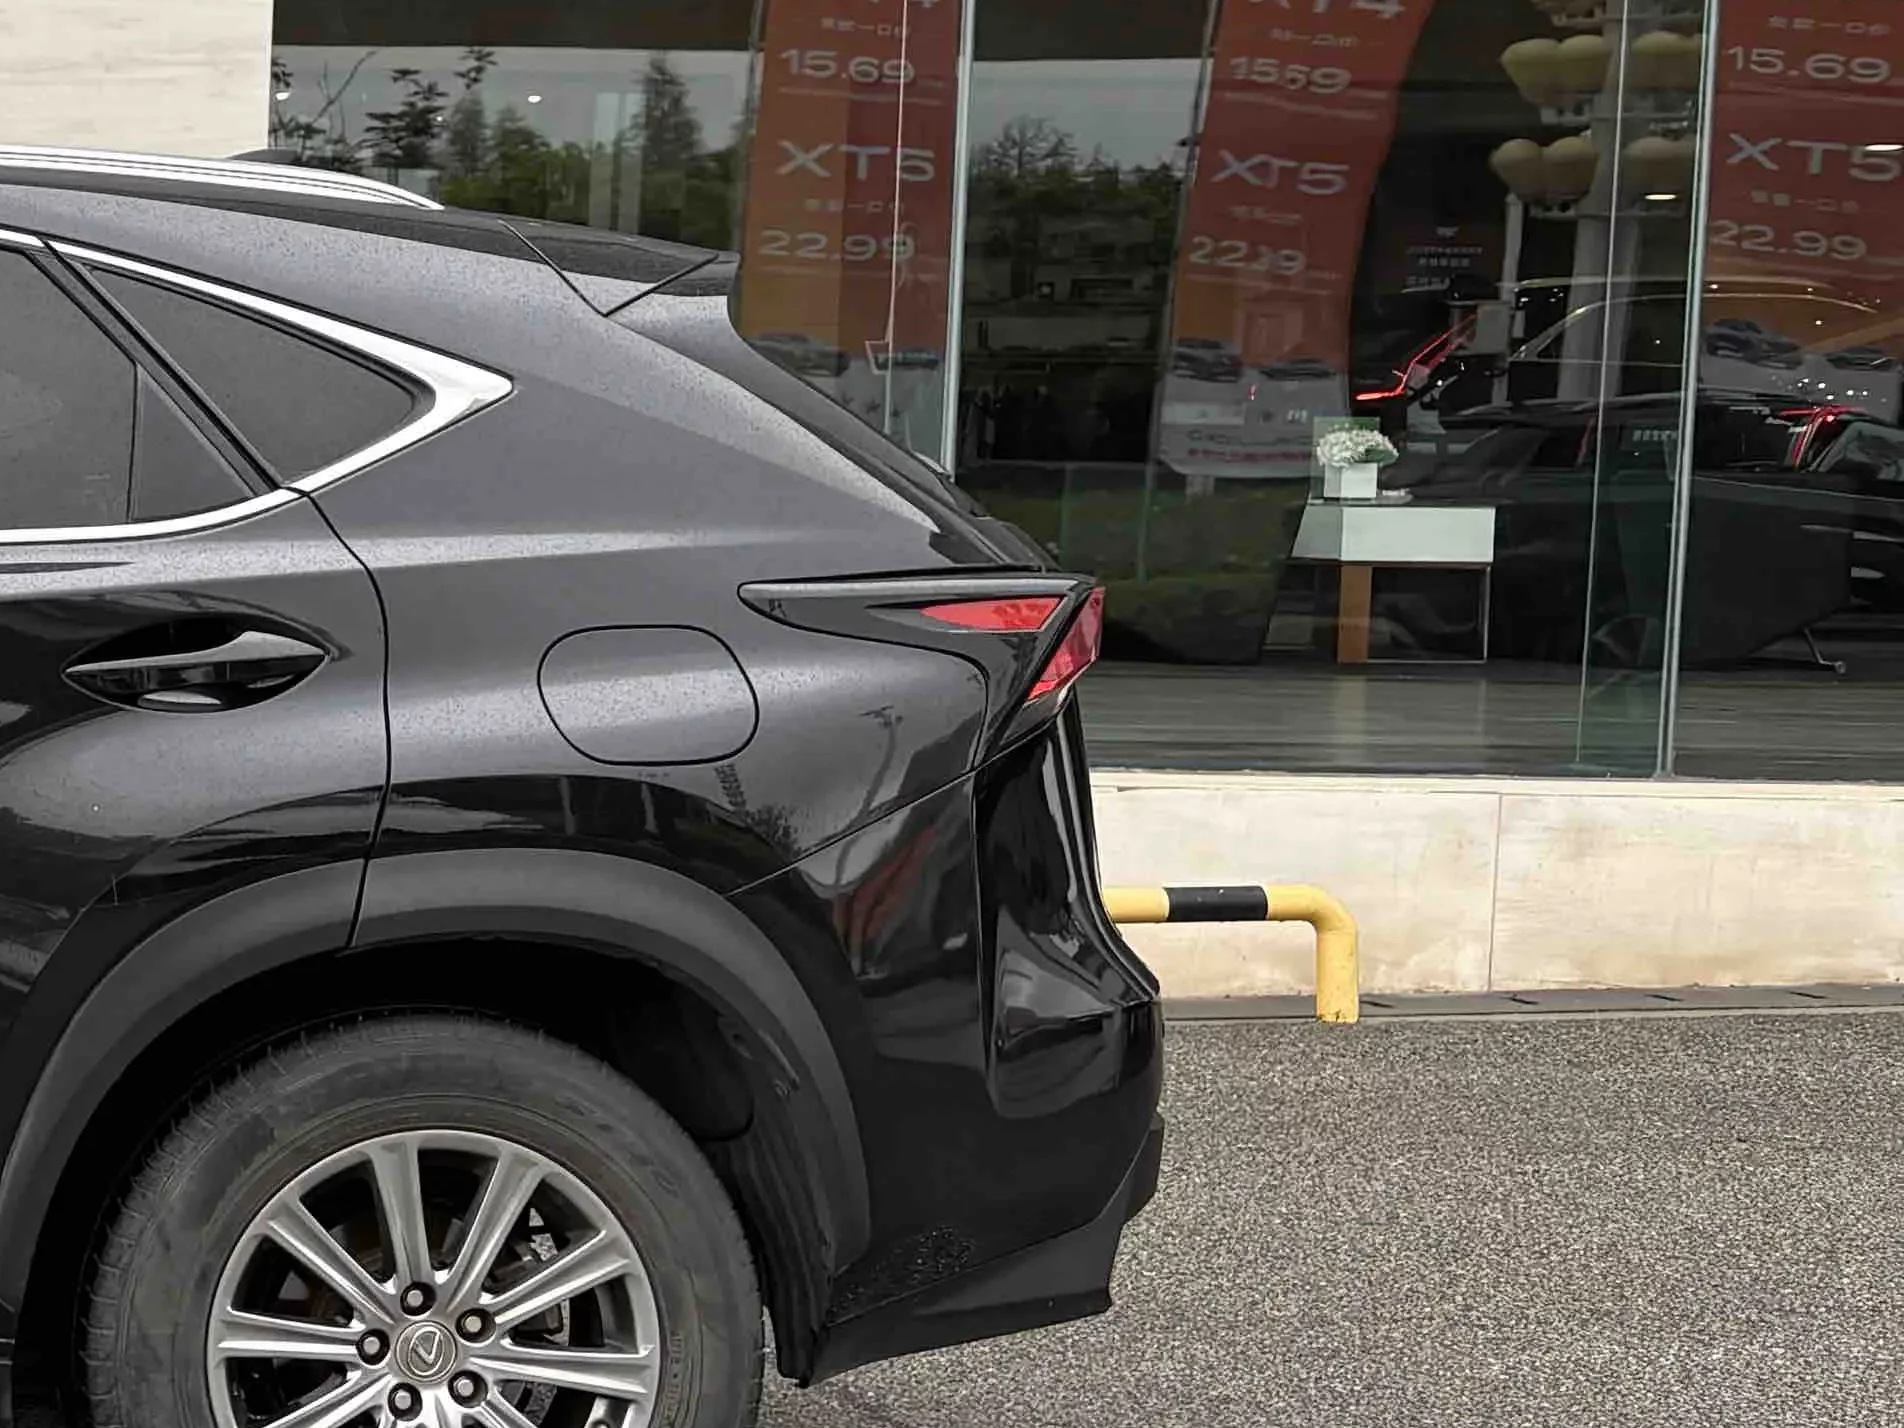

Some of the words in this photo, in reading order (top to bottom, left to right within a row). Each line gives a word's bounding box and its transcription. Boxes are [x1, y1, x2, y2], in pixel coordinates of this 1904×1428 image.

[779, 46, 916, 85] 15.69
[1726, 46, 1892, 84] 15.69
[776, 139, 936, 183] XT5
[1210, 149, 1352, 196] XT5
[1726, 133, 1903, 182] XT5
[1711, 220, 1867, 260] 22.99
